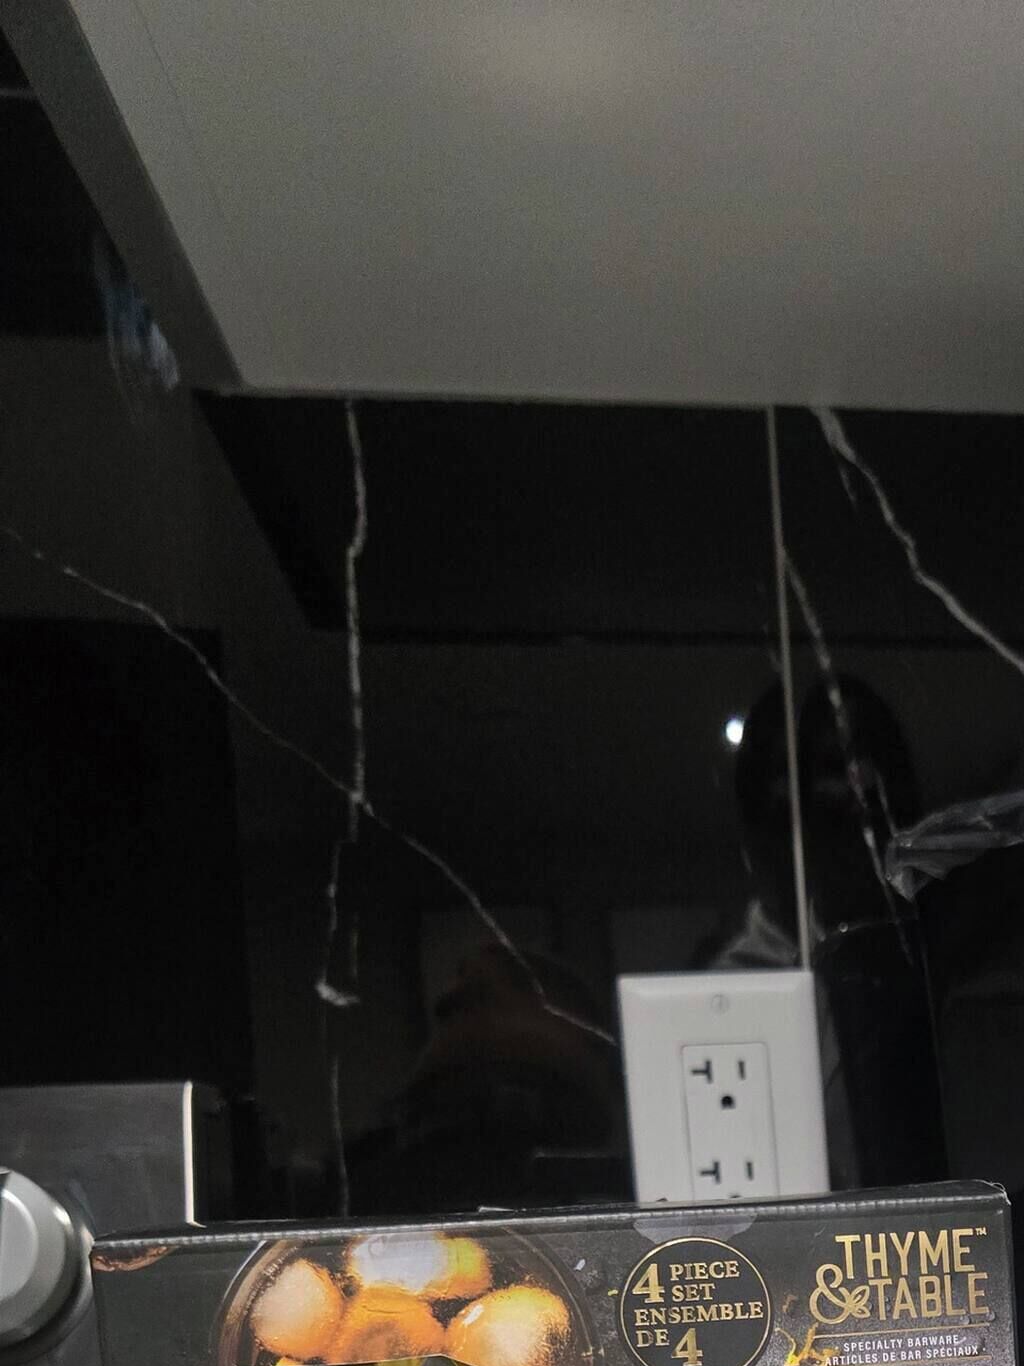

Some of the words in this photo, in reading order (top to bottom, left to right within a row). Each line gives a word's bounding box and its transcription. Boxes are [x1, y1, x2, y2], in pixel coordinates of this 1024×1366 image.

[632, 1263, 665, 1304] 4
[669, 1260, 741, 1282] PIECE
[671, 1283, 716, 1303] SET
[868, 1272, 990, 1321] TABLE
[633, 1301, 764, 1327] ENSEMBLE
[636, 1330, 670, 1348] DE
[843, 1340, 903, 1352] SPECIALTY
[907, 1334, 959, 1348] BARWARE
[825, 1353, 878, 1366] ARTICLES
[882, 1354, 896, 1362] DE
[900, 1350, 922, 1361] BAR
[926, 1345, 979, 1358] SPÉCIAUX
